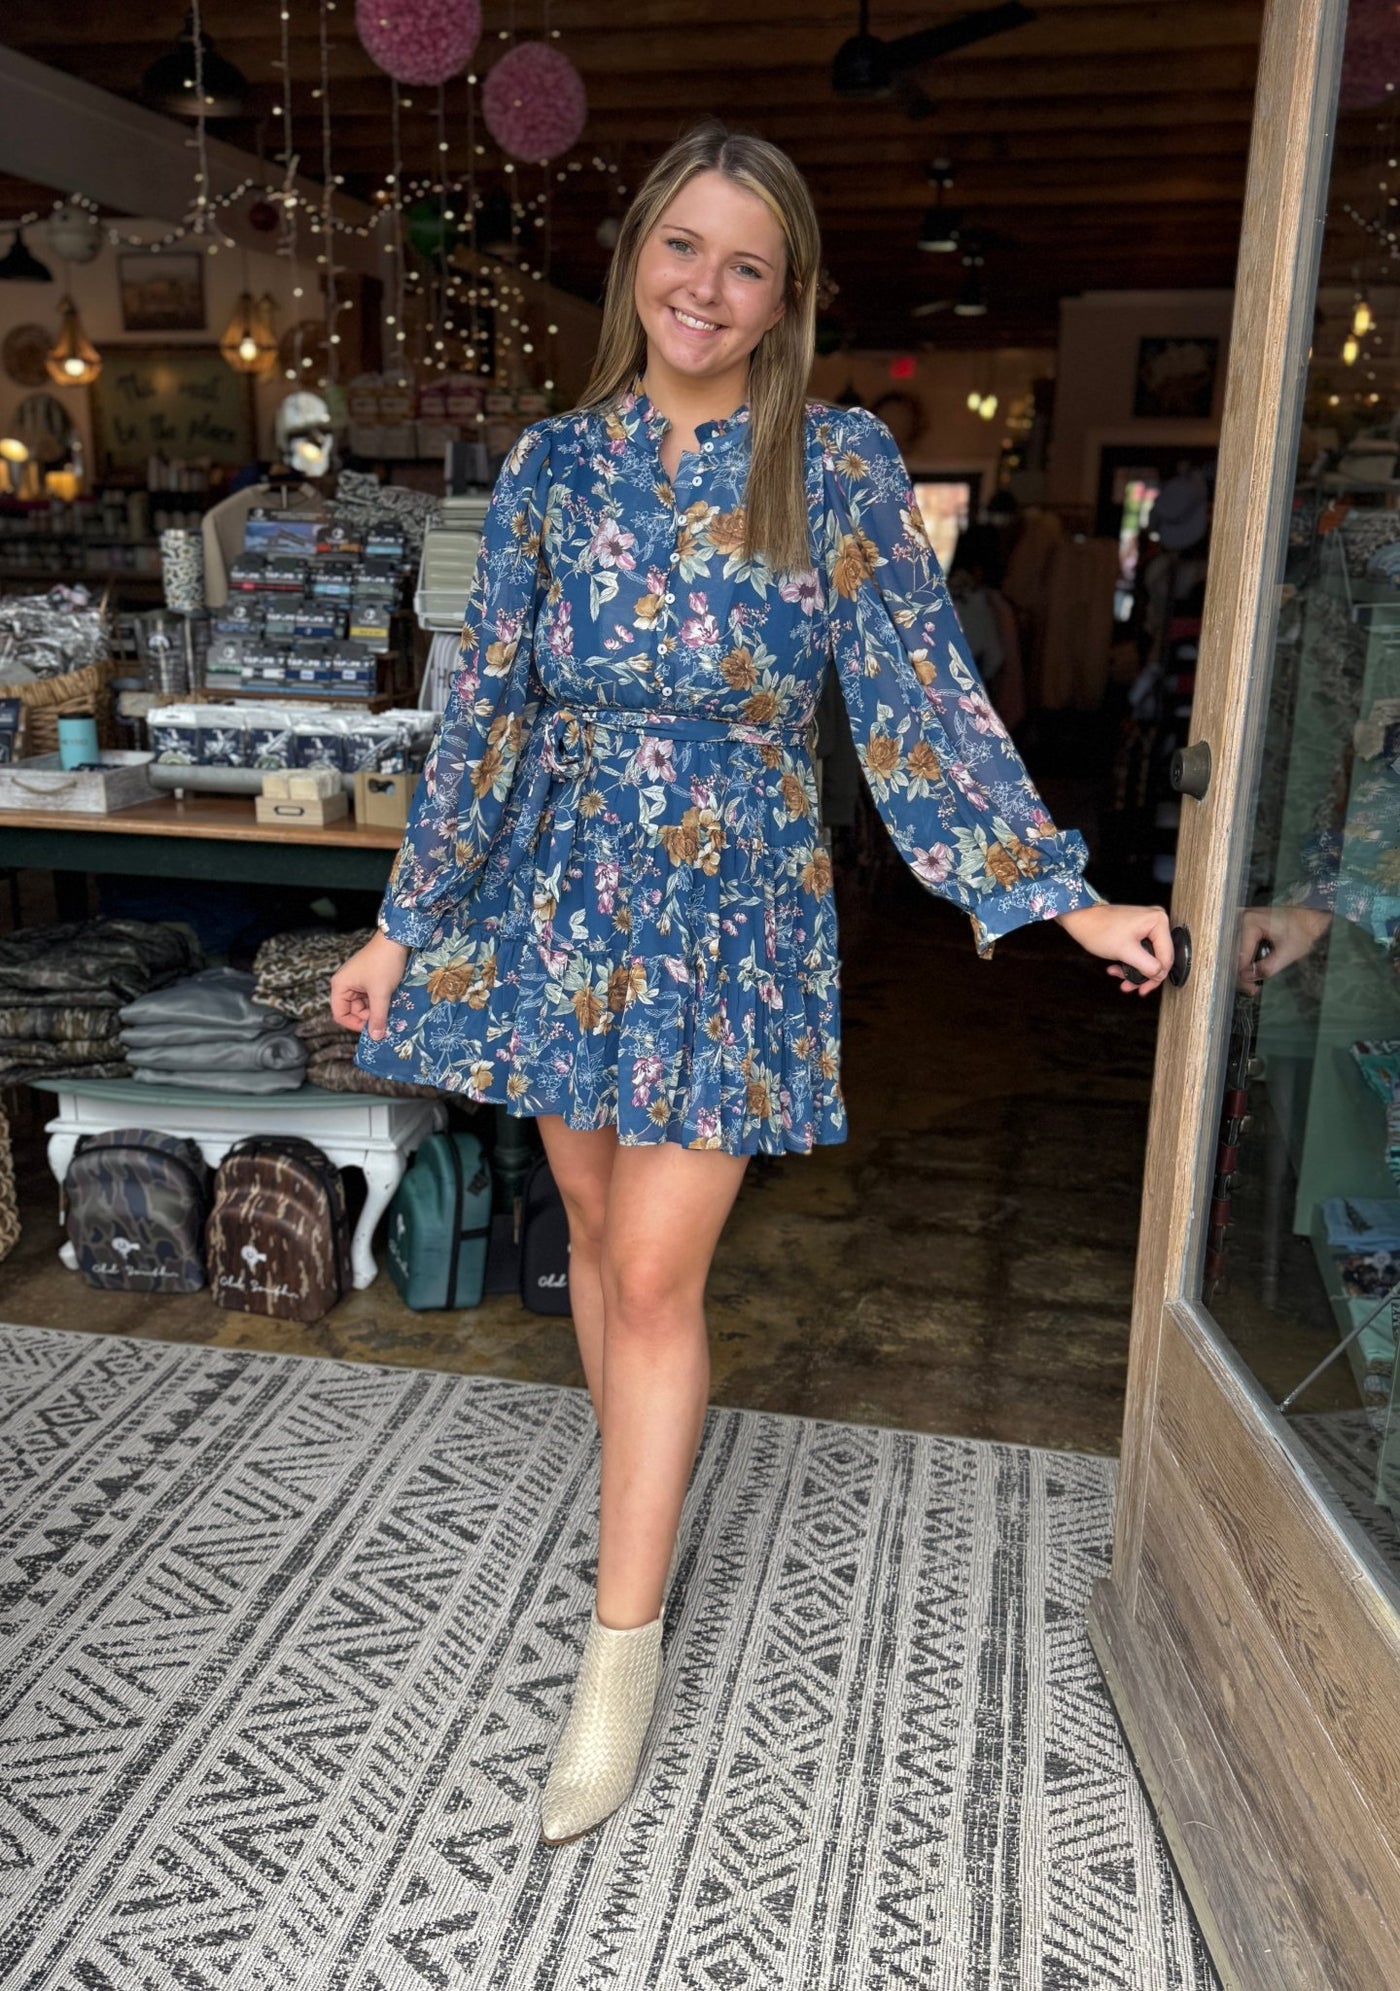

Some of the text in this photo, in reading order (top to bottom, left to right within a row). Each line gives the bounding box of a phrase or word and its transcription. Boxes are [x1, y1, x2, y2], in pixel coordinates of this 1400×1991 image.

[91, 1263, 119, 1274] Old
[219, 1275, 245, 1291] Old
[537, 1273, 567, 1288] Old
